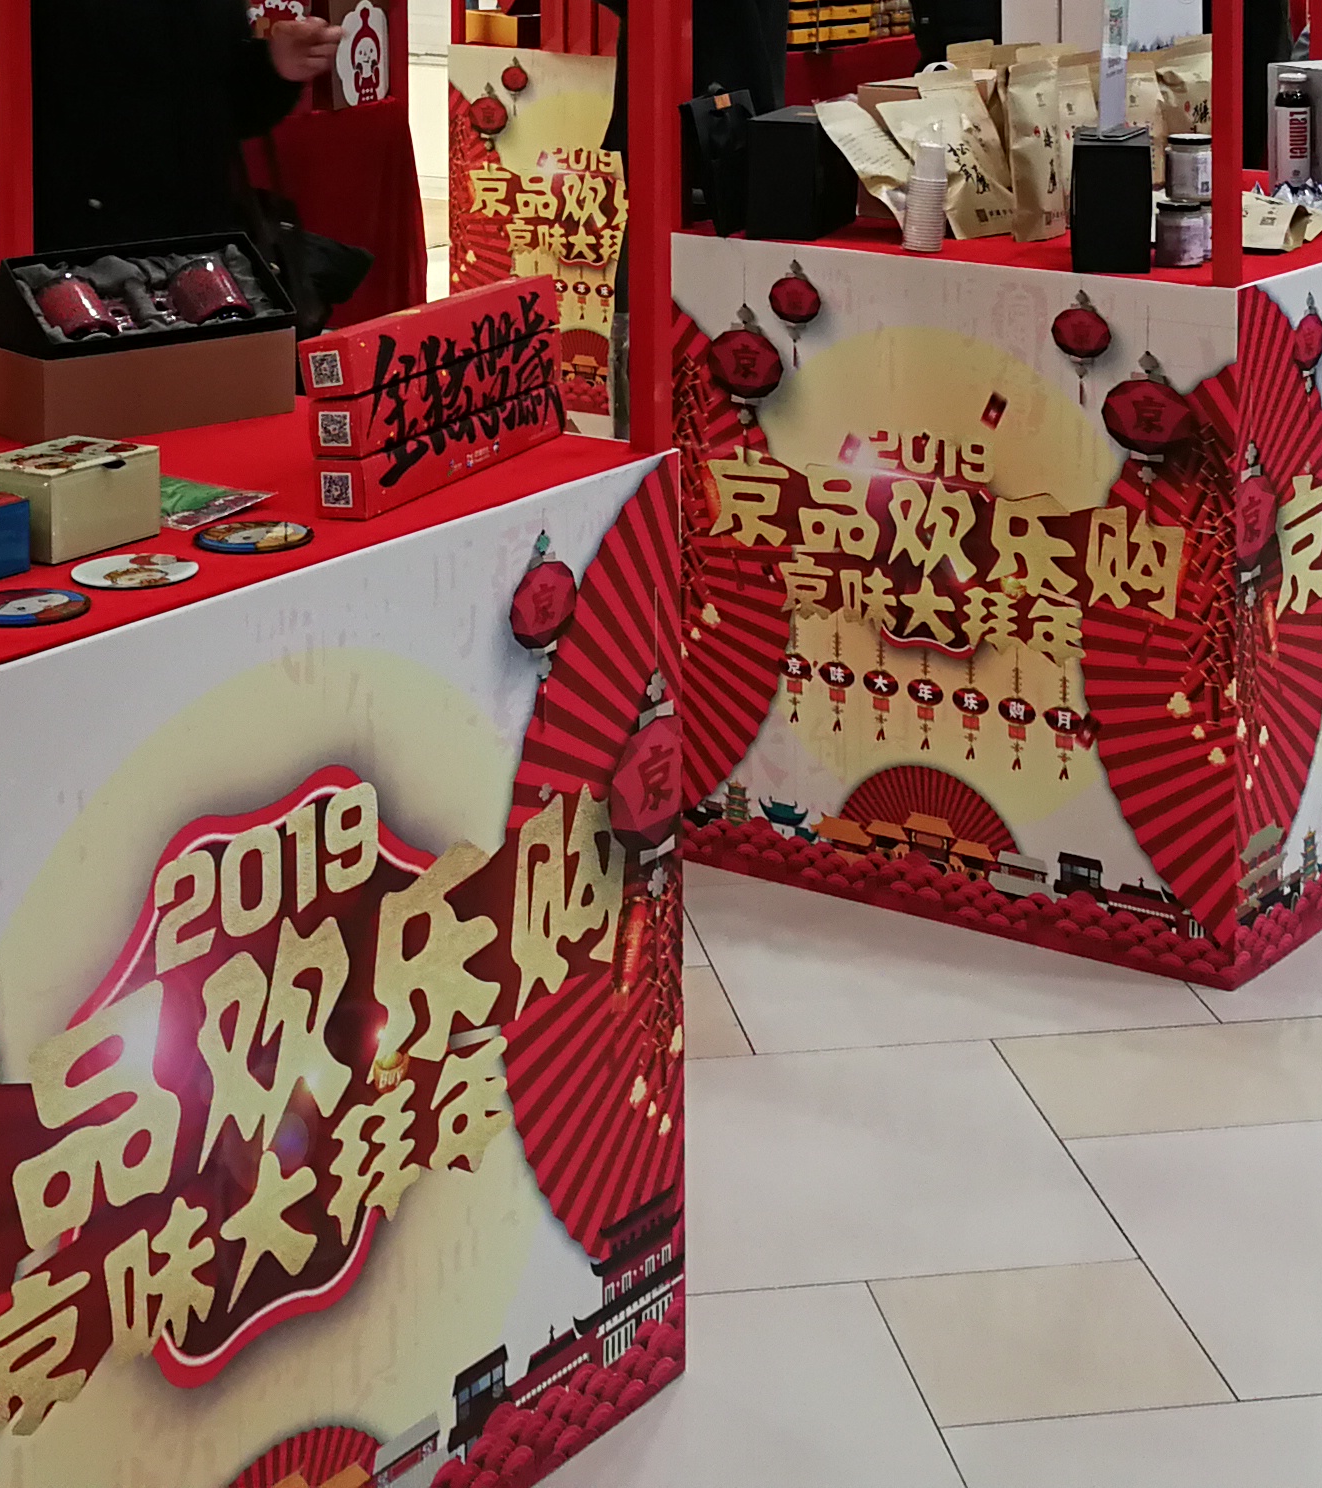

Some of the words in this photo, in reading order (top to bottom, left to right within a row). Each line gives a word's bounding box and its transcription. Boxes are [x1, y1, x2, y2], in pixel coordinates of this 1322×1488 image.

[553, 146, 615, 172] 2019
[1288, 110, 1308, 160] Lanmei
[1129, 394, 1169, 442] 京
[869, 429, 996, 484] 2019
[708, 445, 1185, 620] 京品欢乐购
[778, 554, 1086, 667] 京味大拜年
[786, 657, 1073, 731] 京味大年乐购月
[154, 781, 381, 974] 2019
